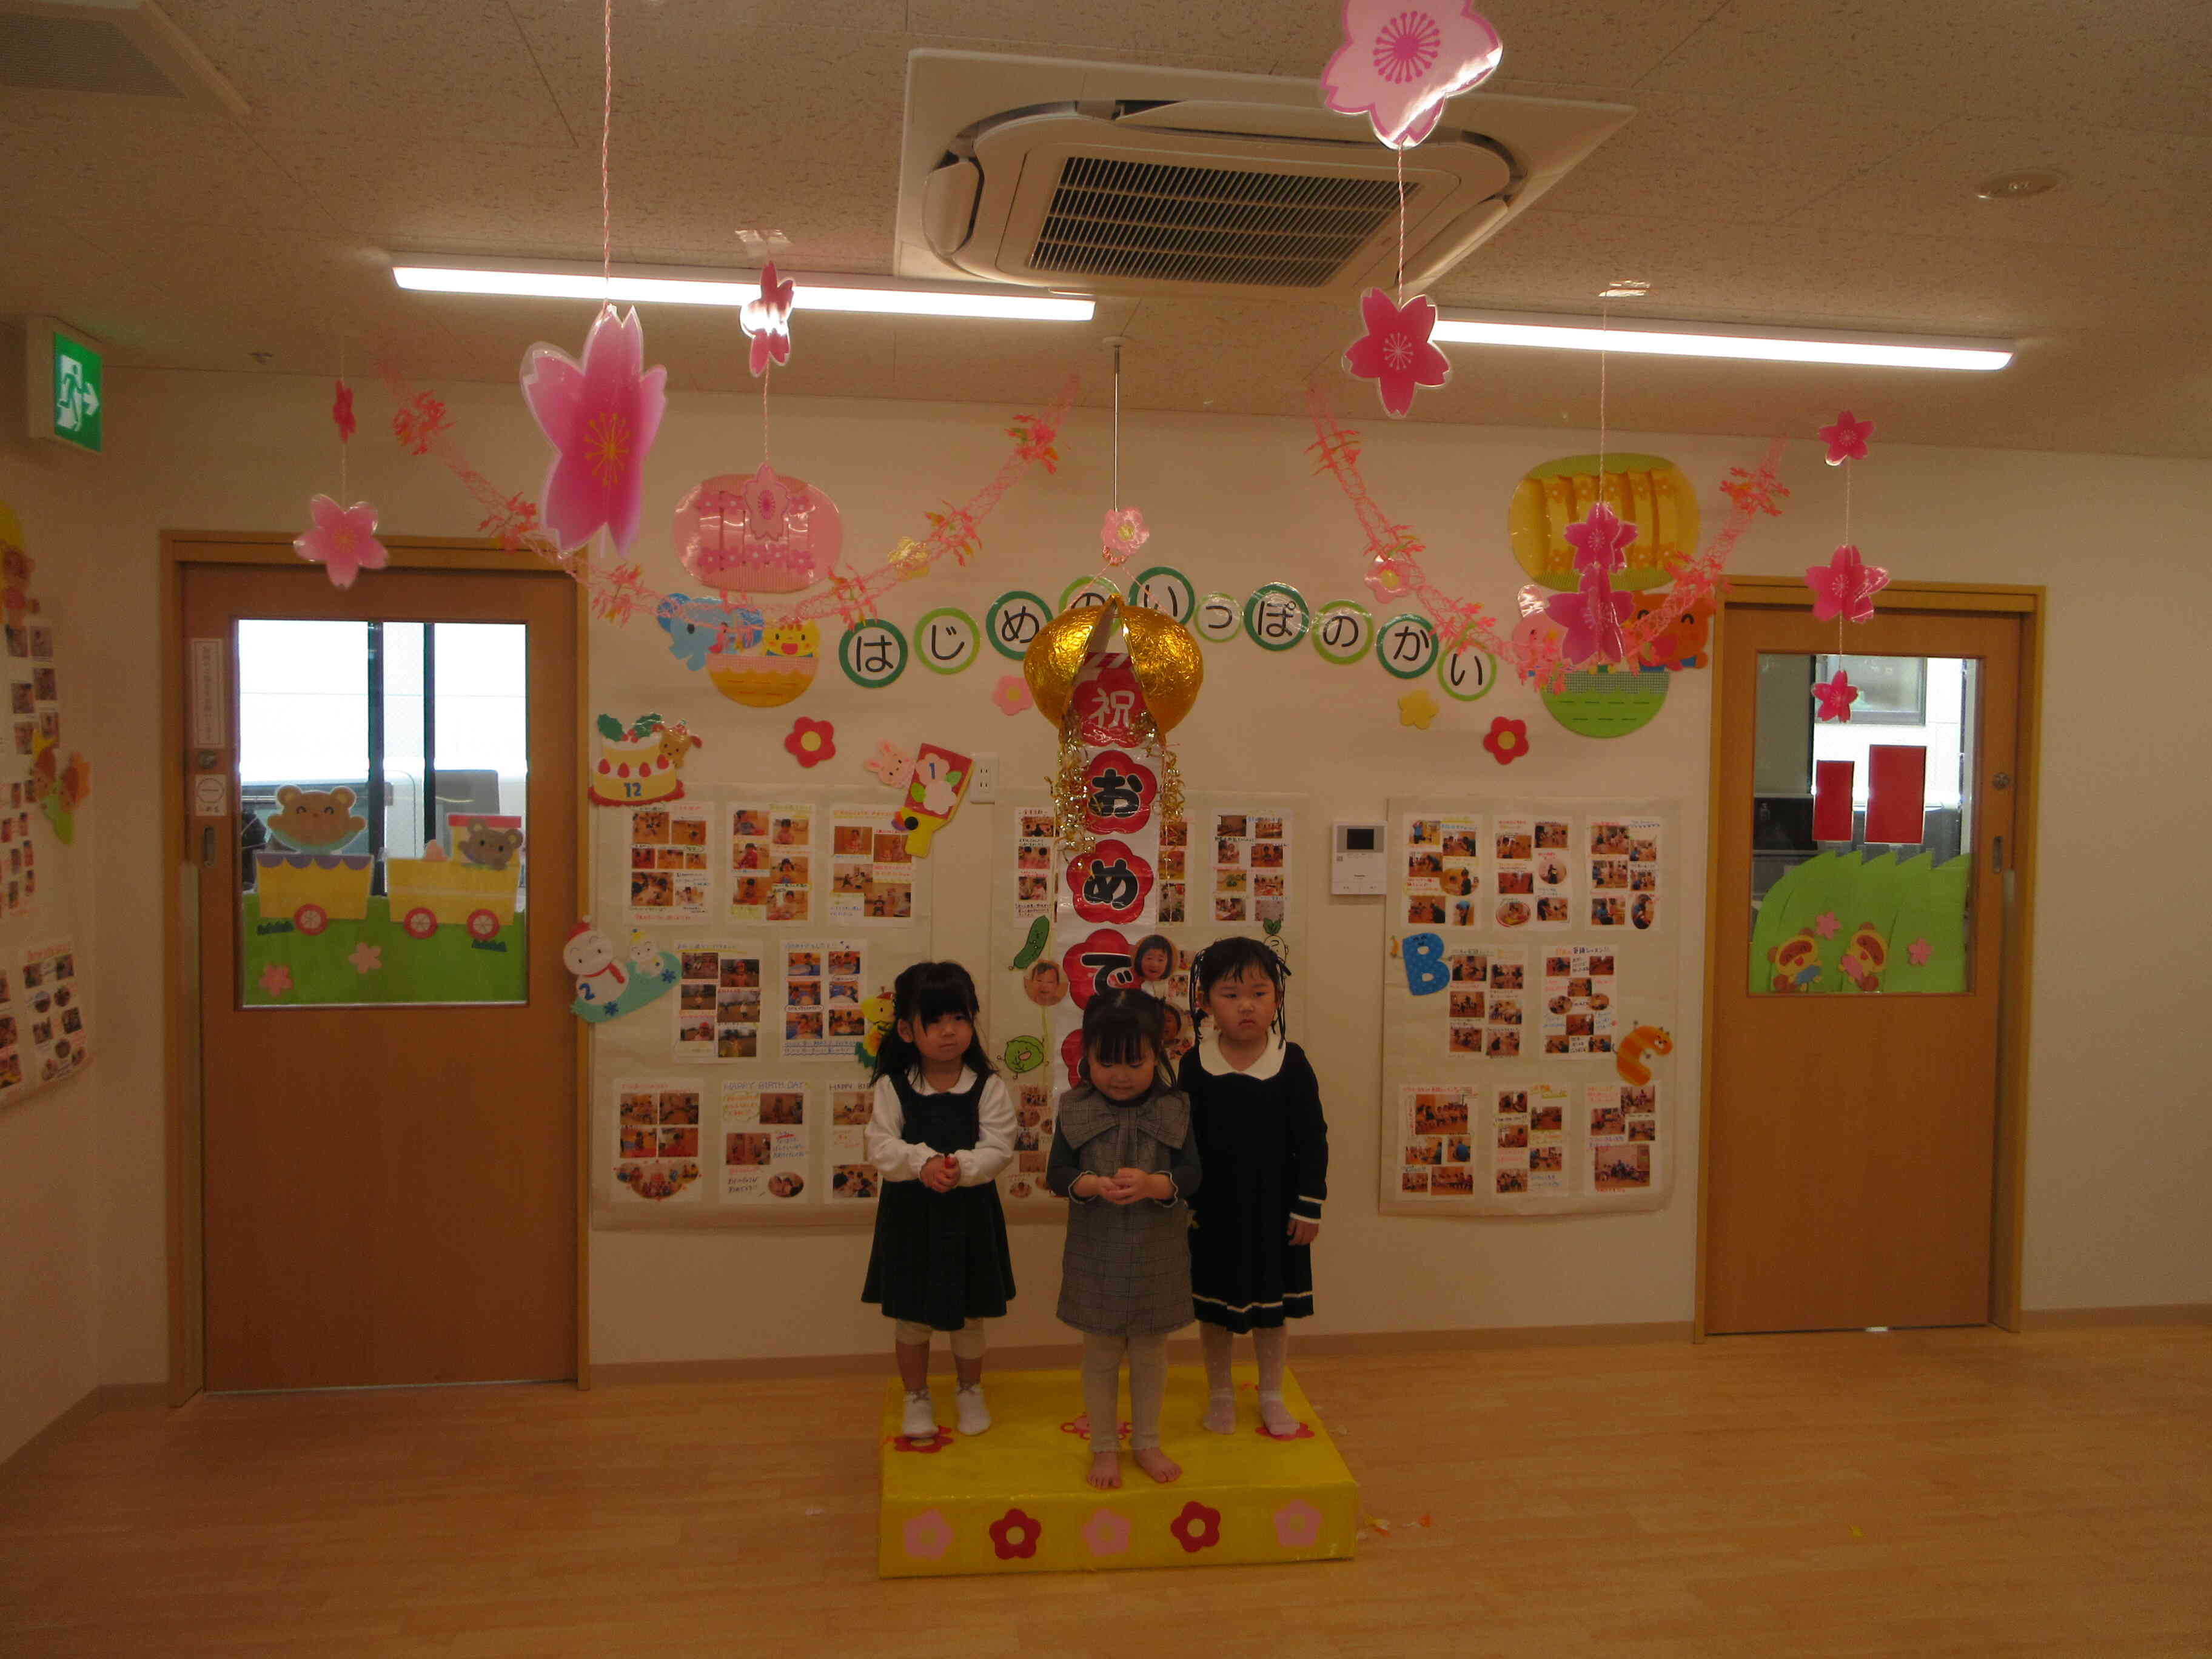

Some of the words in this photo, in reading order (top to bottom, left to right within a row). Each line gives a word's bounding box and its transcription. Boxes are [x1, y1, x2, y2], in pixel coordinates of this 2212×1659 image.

[1090, 688, 1136, 728] 祝
[929, 762, 936, 780] 1
[624, 782, 642, 797] 12
[1402, 933, 1450, 996] B
[578, 983, 595, 1000] 2
